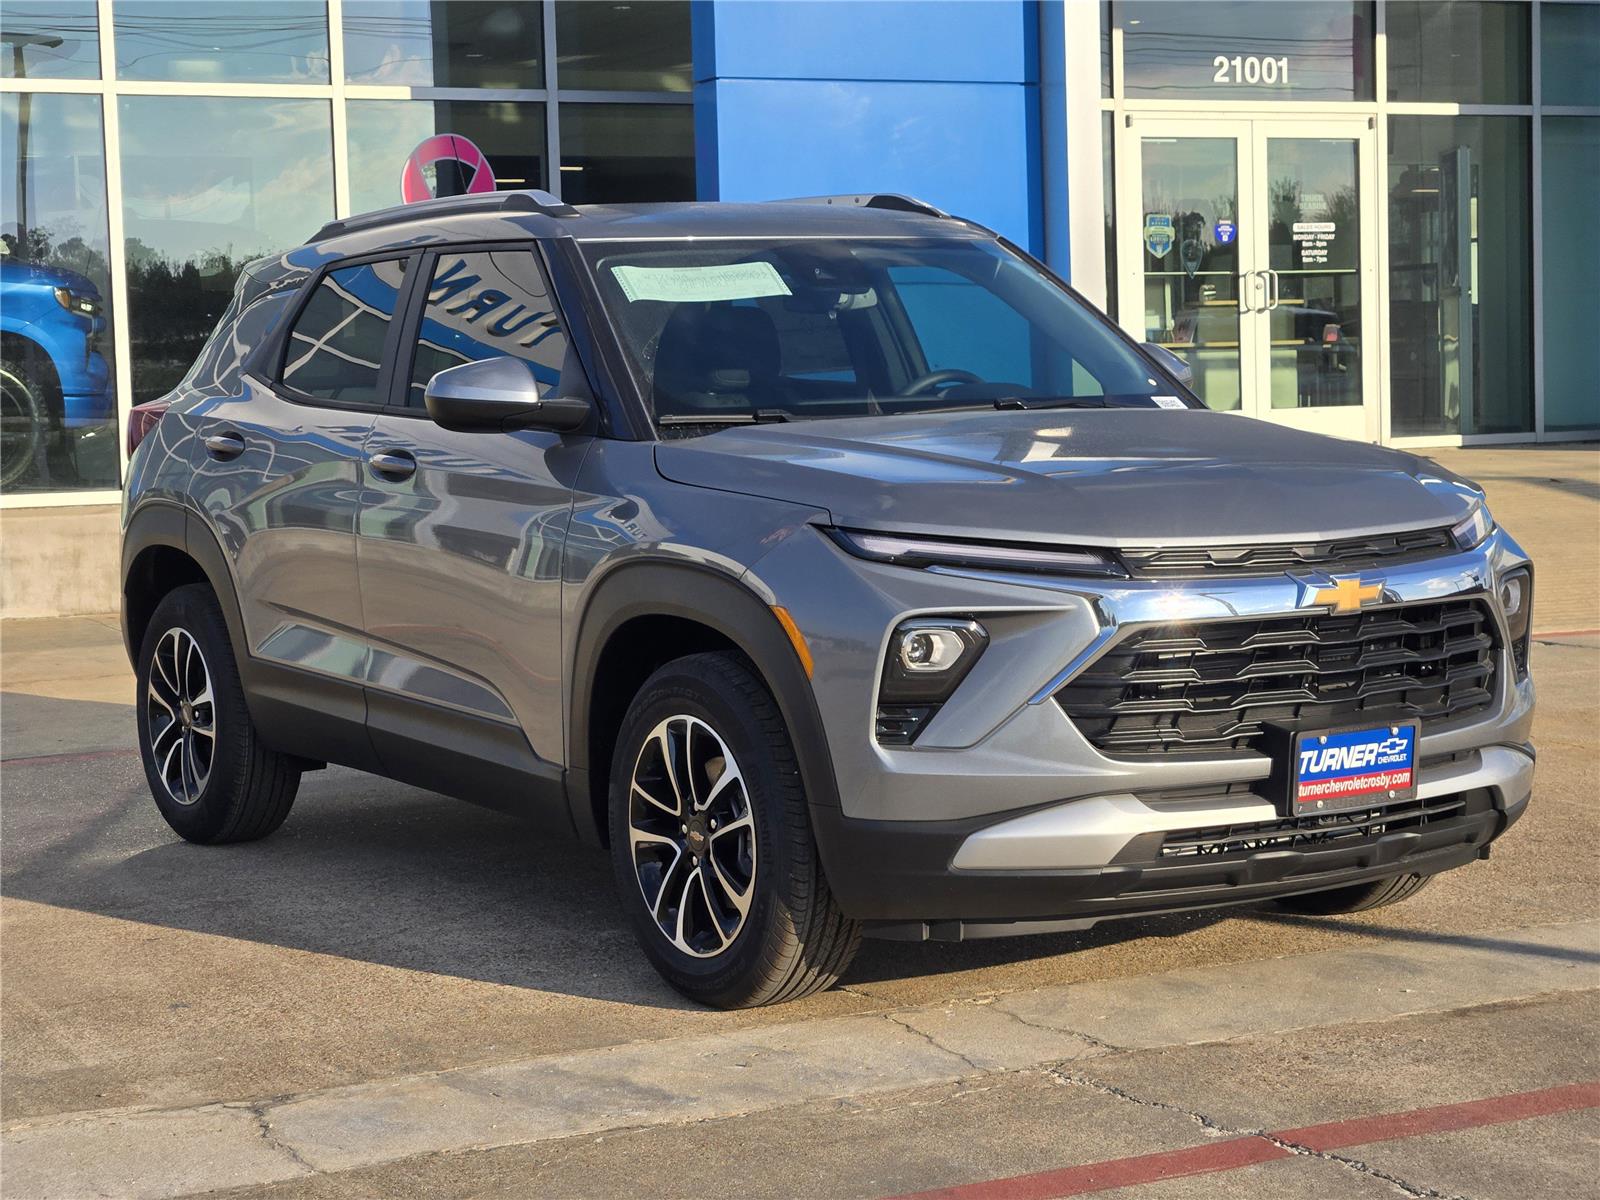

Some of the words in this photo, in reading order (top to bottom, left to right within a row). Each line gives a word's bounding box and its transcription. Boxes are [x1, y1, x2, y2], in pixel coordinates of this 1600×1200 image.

[1213, 55, 1288, 84] 21001
[1299, 742, 1379, 774] TURNER
[1377, 753, 1408, 765] CHEVROLET
[1298, 771, 1410, 797] turnerchevroletcrosby.com
